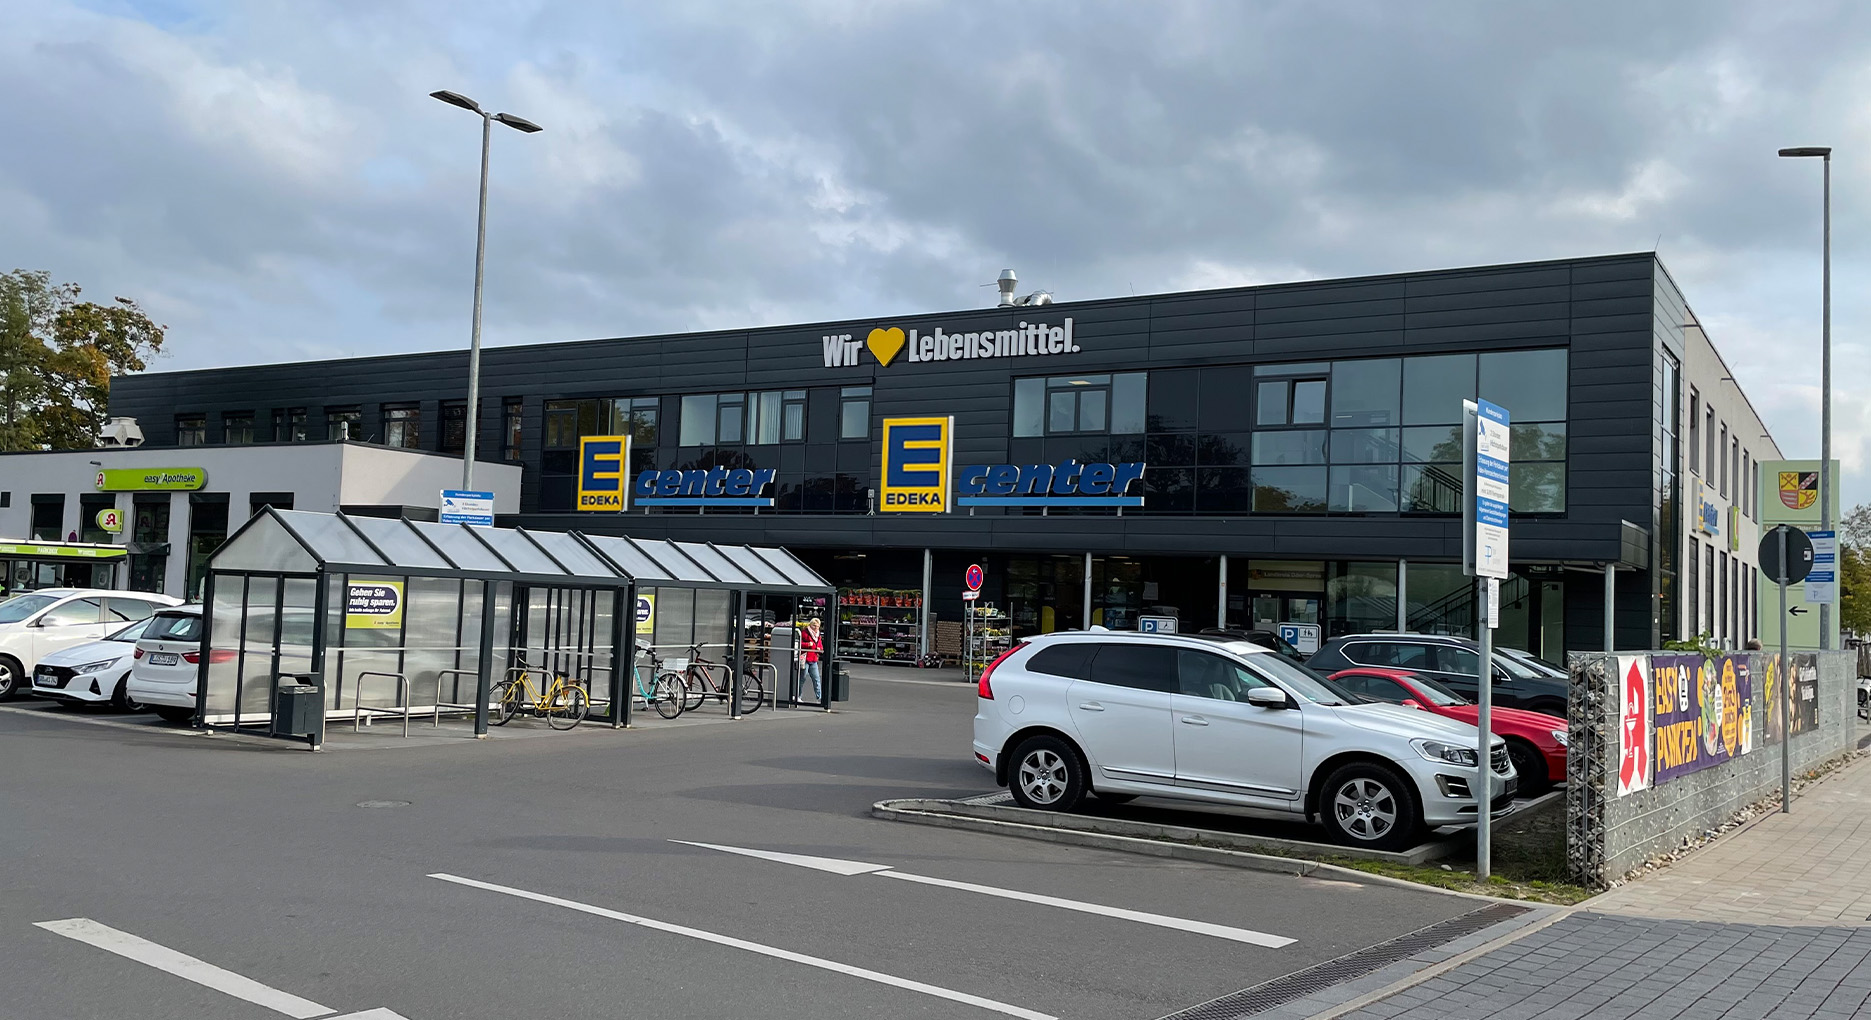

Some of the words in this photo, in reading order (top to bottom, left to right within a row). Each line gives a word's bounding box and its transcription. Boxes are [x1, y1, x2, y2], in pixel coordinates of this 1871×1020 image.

[823, 334, 863, 368] Wir
[908, 318, 1080, 363] Lebensmittel.
[635, 465, 776, 496] center
[958, 459, 1146, 495] center
[581, 496, 620, 506] EDEKA
[885, 493, 941, 505] EDEKA
[350, 588, 373, 597] Gehen
[374, 588, 385, 597] Sie
[349, 597, 369, 607] ruhig
[1284, 629, 1295, 641] P
[1655, 667, 1678, 715] EASY
